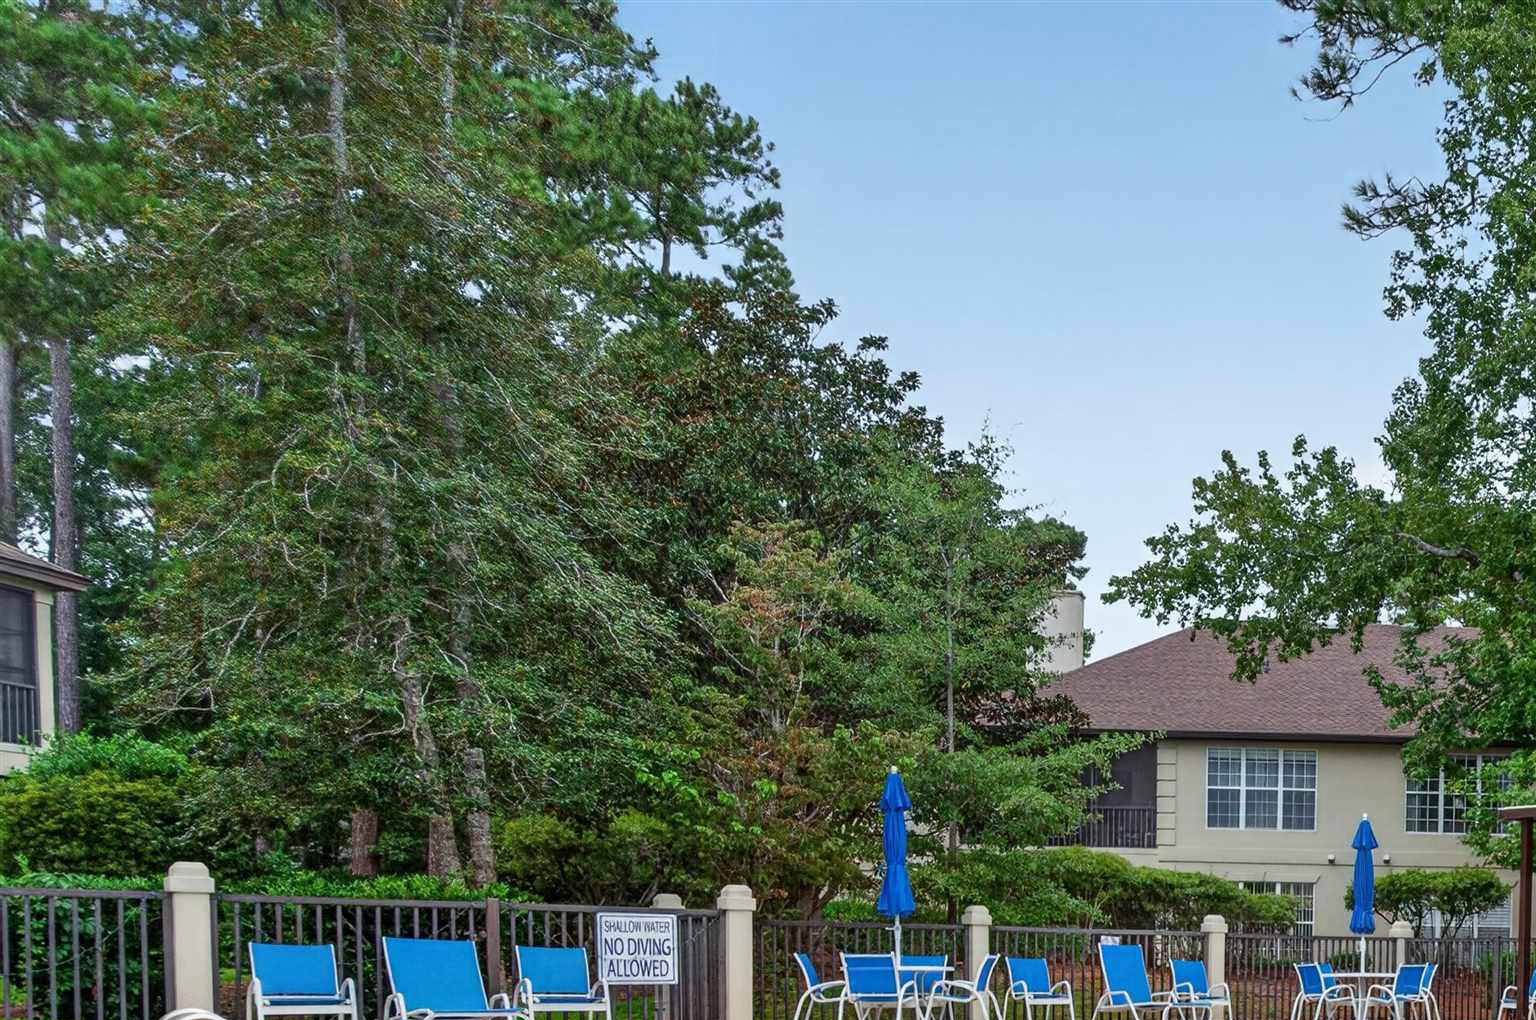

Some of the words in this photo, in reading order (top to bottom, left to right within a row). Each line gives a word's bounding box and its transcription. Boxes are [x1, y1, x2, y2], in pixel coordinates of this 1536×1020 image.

[604, 920, 641, 933] SHALLOW
[644, 921, 670, 933] WATER
[604, 938, 624, 955] NO
[628, 938, 671, 956] DIVING
[607, 959, 669, 977] ALLOWED
